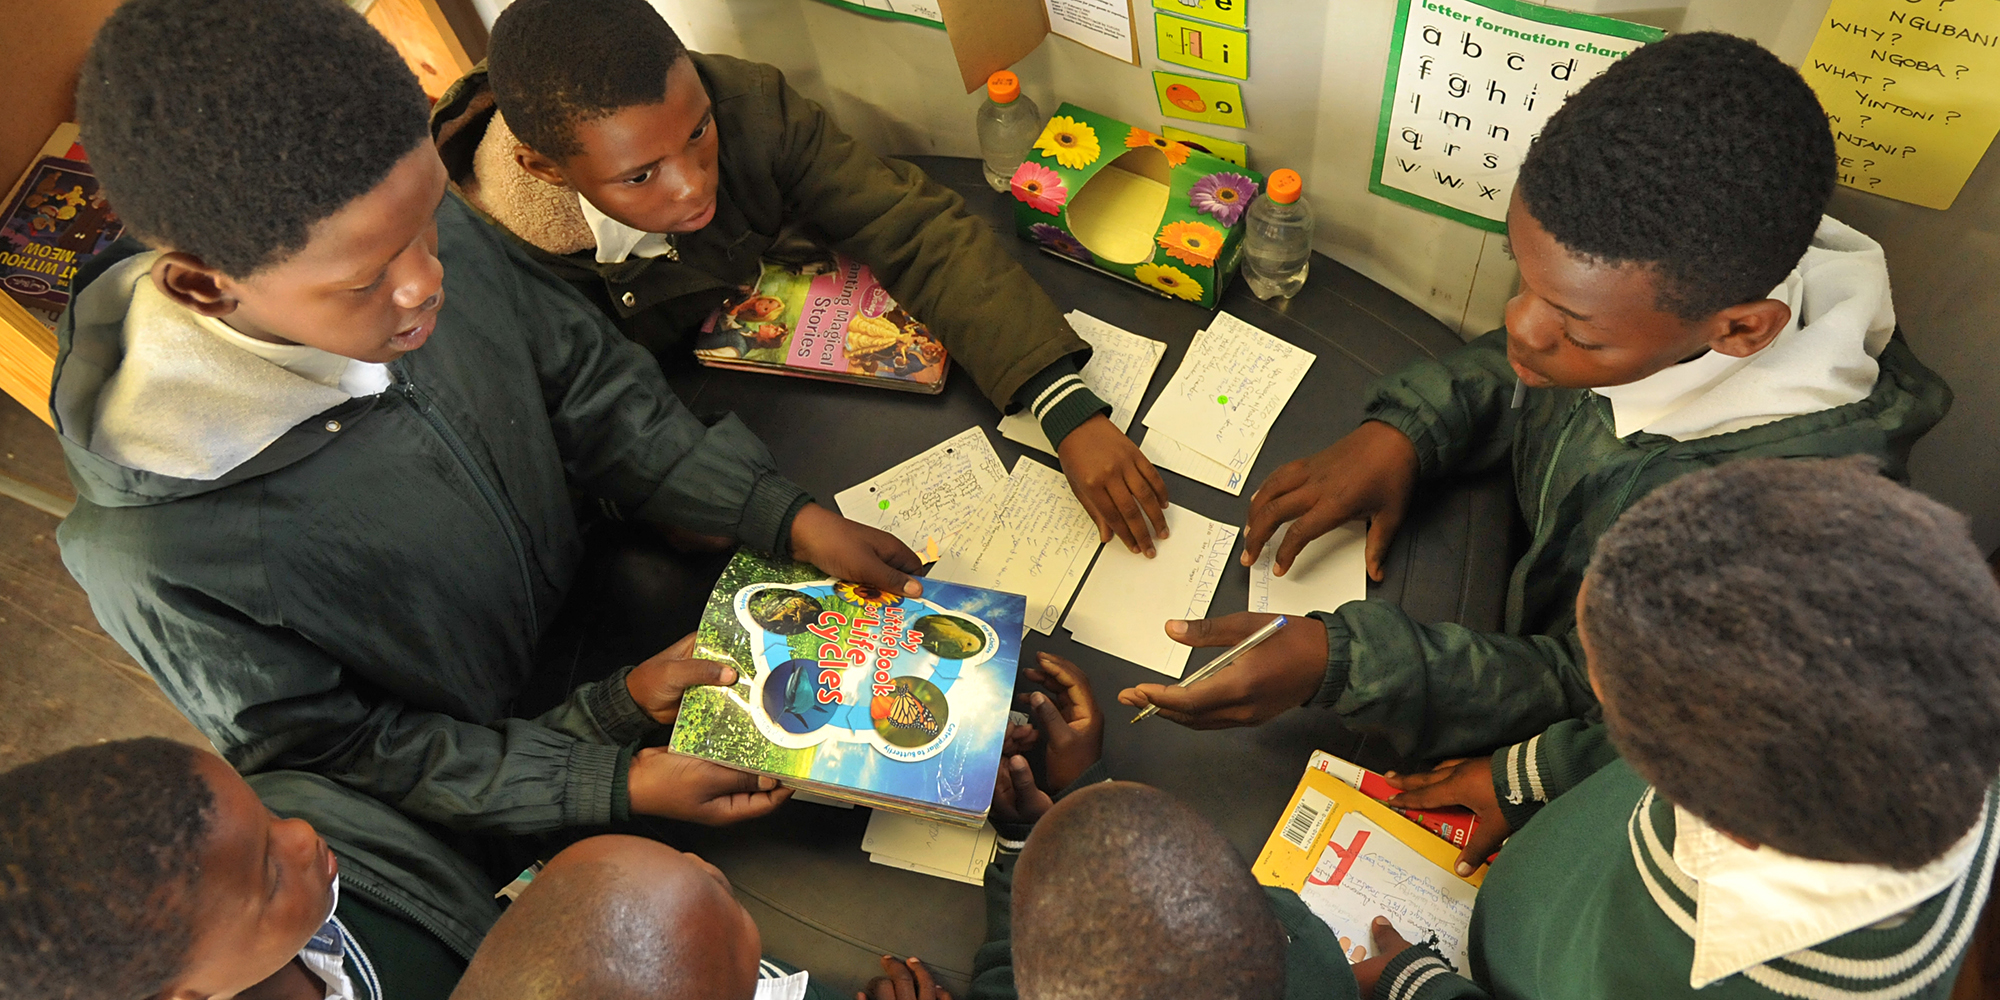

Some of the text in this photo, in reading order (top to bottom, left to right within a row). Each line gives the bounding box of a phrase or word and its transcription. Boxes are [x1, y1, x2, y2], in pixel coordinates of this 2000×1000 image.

[1422, 0, 1628, 60] letter formation chart
[1889, 11, 1998, 47] NGUBANI
[1223, 44, 1228, 63] i
[1423, 28, 1574, 81] a b c d
[1871, 49, 1945, 77] NGOBA
[1420, 60, 1536, 111] f g h i
[1815, 59, 1872, 84] WHAT
[1216, 101, 1233, 114] o
[1855, 90, 1934, 121] YINTONI
[1444, 110, 1471, 130] m
[1492, 125, 1509, 141] n
[1402, 129, 1497, 169] q r s
[1400, 159, 1494, 200] v w x
[0, 251, 78, 280] AT WITHOU
[22, 242, 76, 263] MEOW
[797, 296, 831, 358] Stories
[820, 262, 861, 367] anting Magical
[1225, 470, 1243, 490] 2E
[845, 605, 881, 665] of Life
[900, 630, 923, 653] My
[806, 610, 849, 704] Cycles
[872, 606, 904, 696] Little Book
[884, 744, 916, 757] Butterfly
[926, 723, 956, 753] Caterpillar
